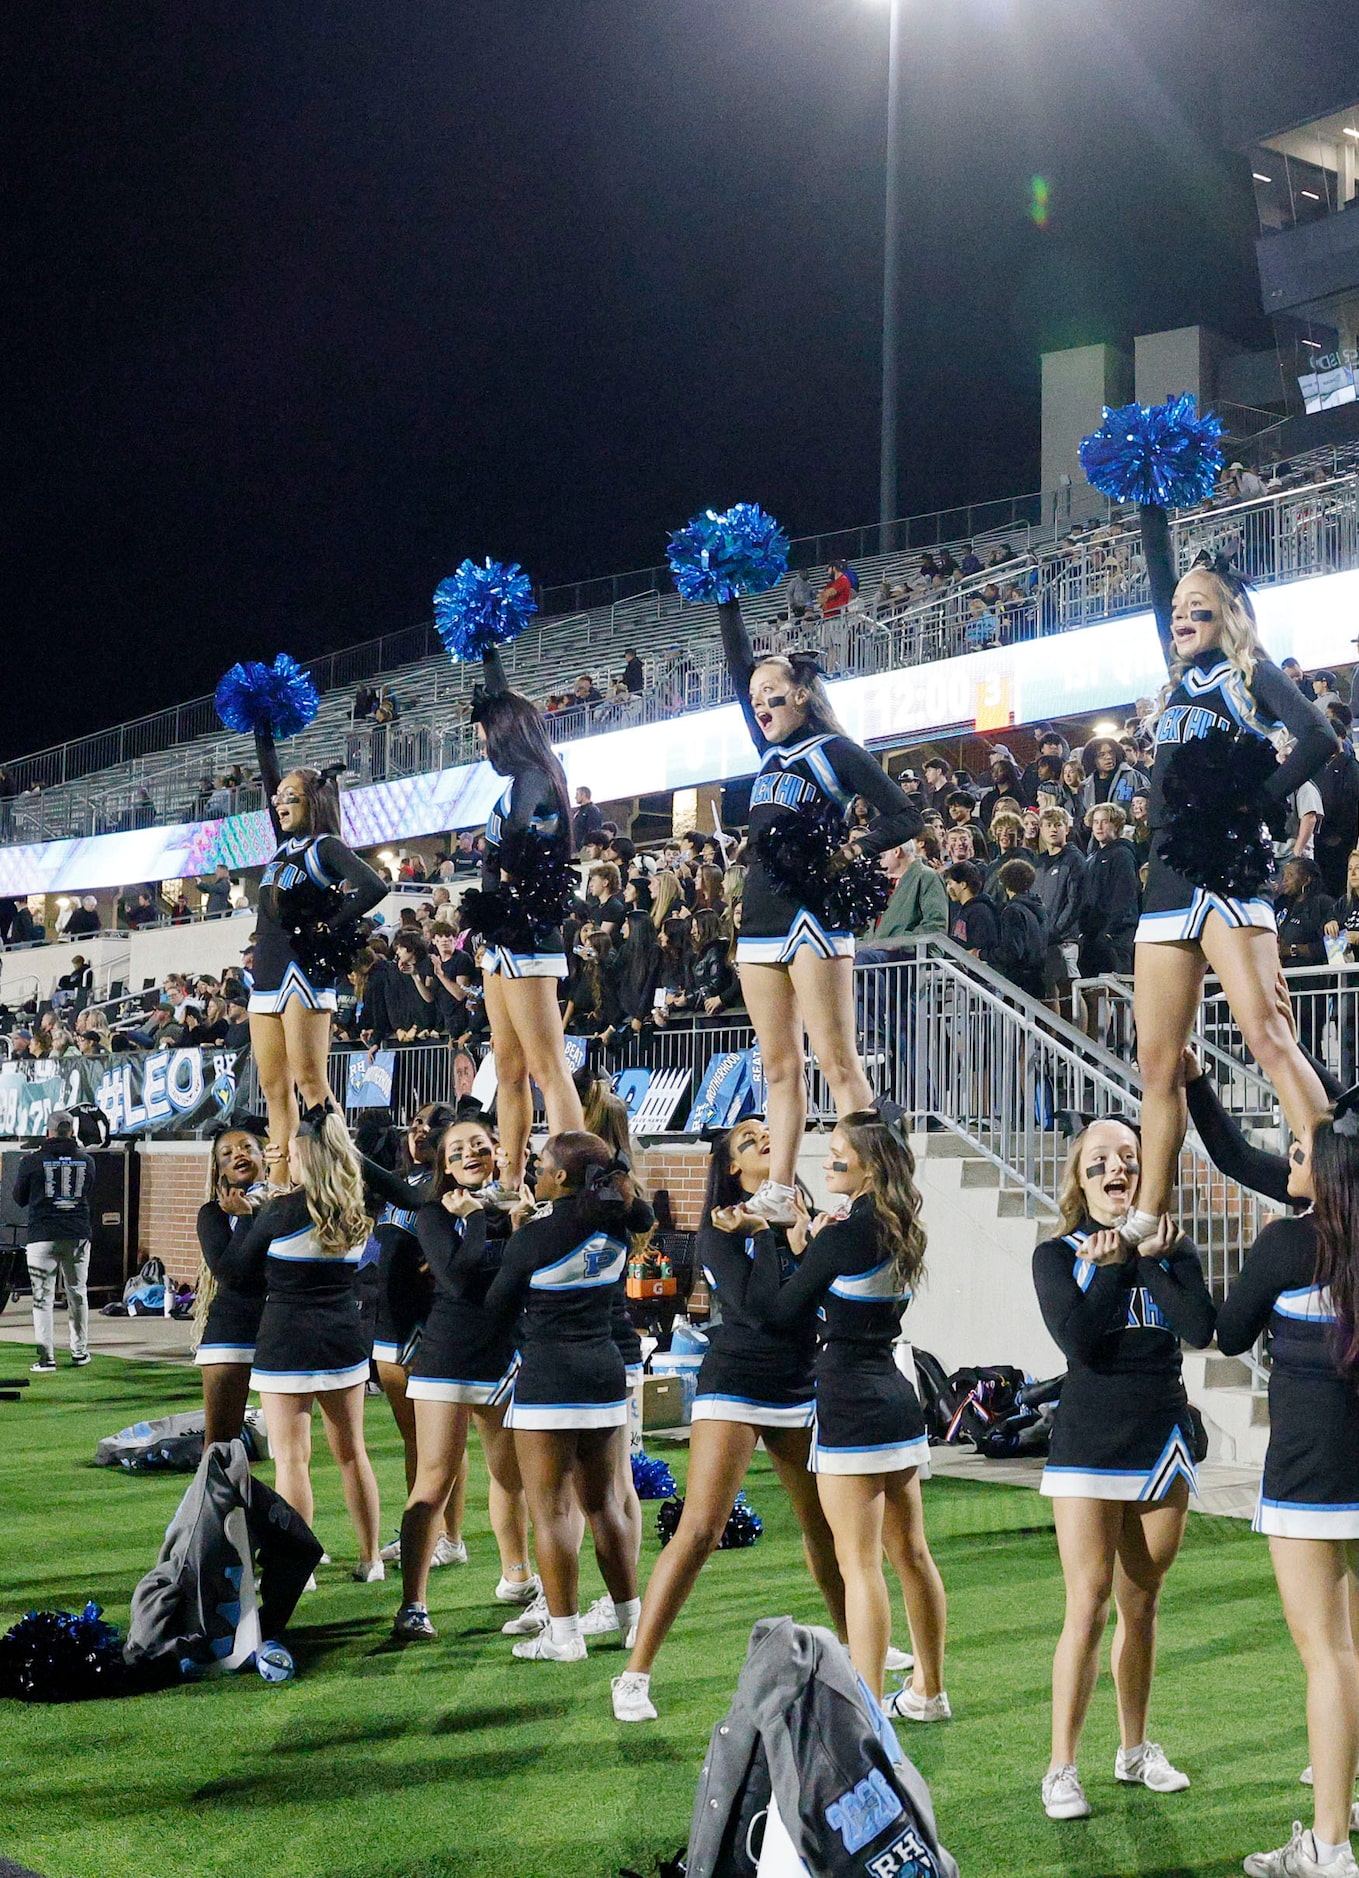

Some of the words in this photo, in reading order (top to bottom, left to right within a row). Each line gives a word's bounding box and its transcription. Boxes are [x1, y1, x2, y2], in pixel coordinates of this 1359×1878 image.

[565, 1040, 584, 1067] BEAT
[584, 1249, 617, 1278] P
[653, 1282, 664, 1295] G
